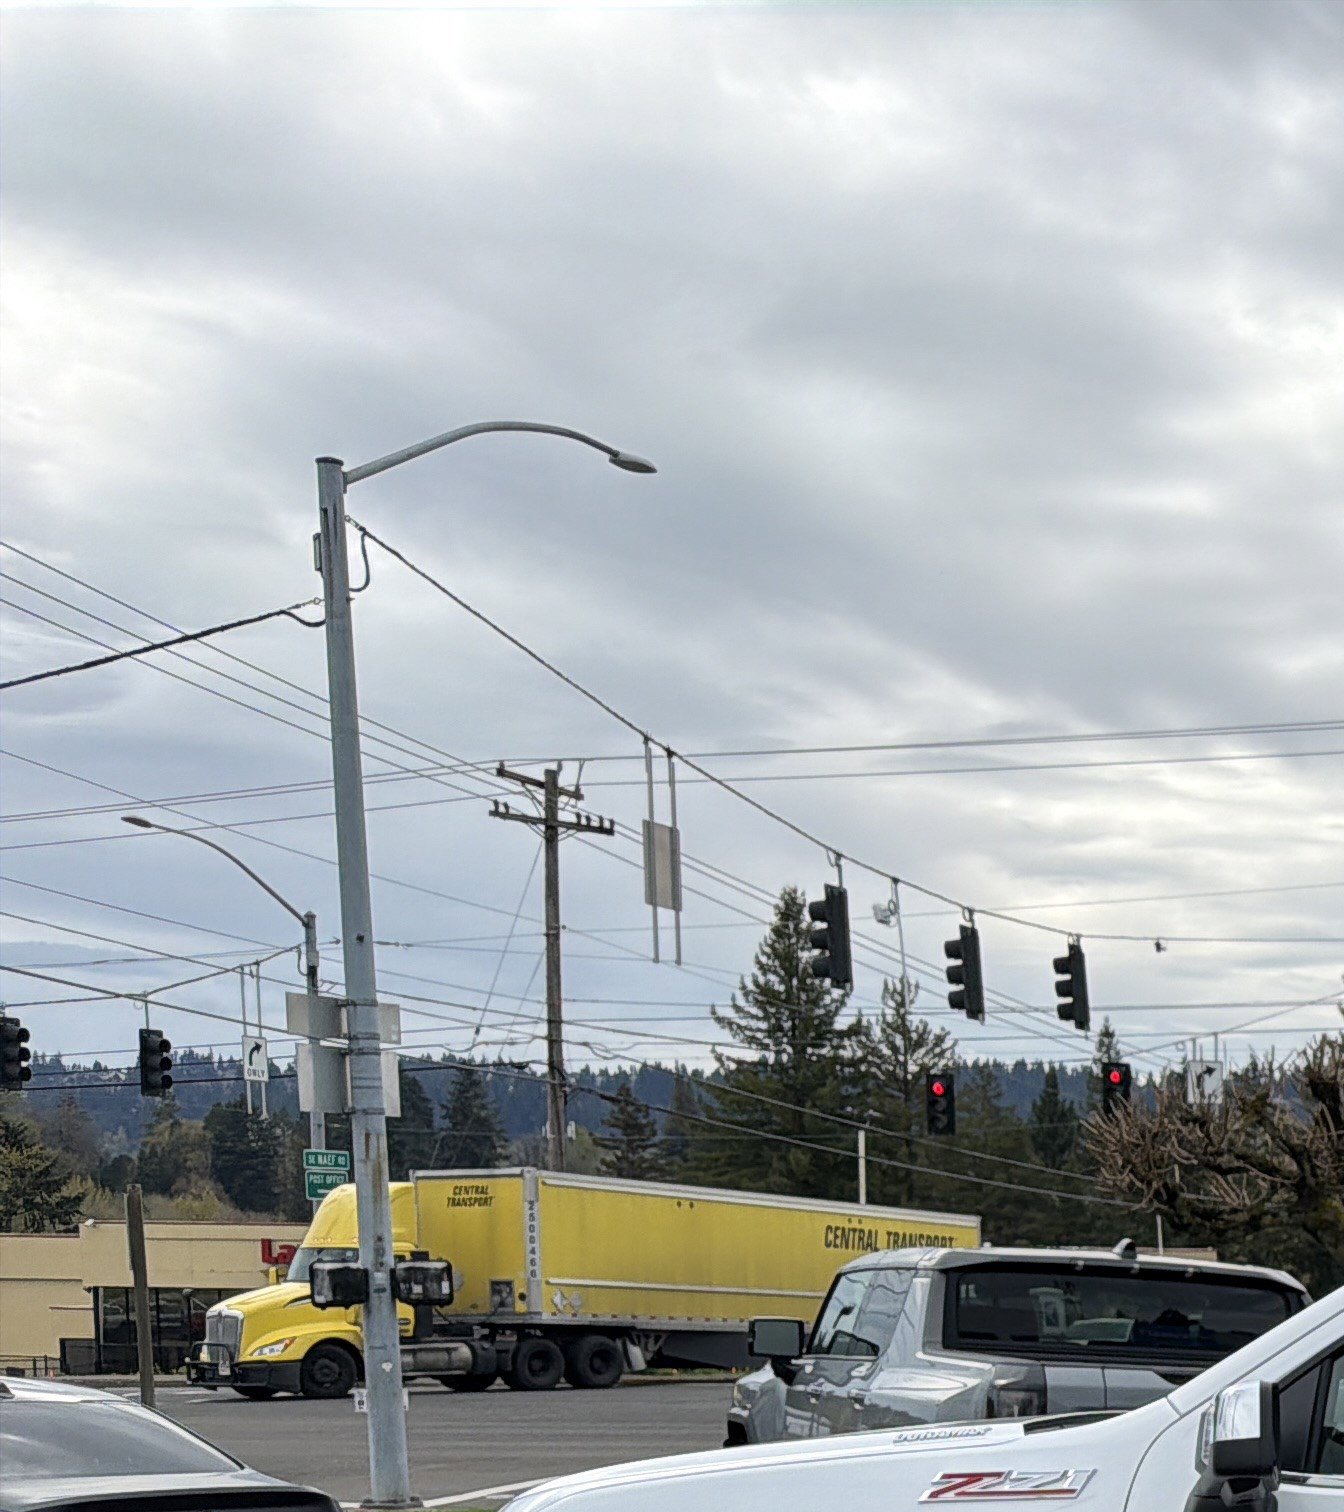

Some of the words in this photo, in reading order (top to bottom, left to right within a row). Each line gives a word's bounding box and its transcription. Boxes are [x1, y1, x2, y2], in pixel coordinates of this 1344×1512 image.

[246, 1068, 266, 1078] ONLY
[453, 1185, 490, 1196] CENTRAL
[447, 1196, 493, 1208] TRANSPORT
[824, 1224, 880, 1252] CENTRAL
[886, 1230, 955, 1250] TRANSPORT
[918, 1468, 1098, 1504] Z71
